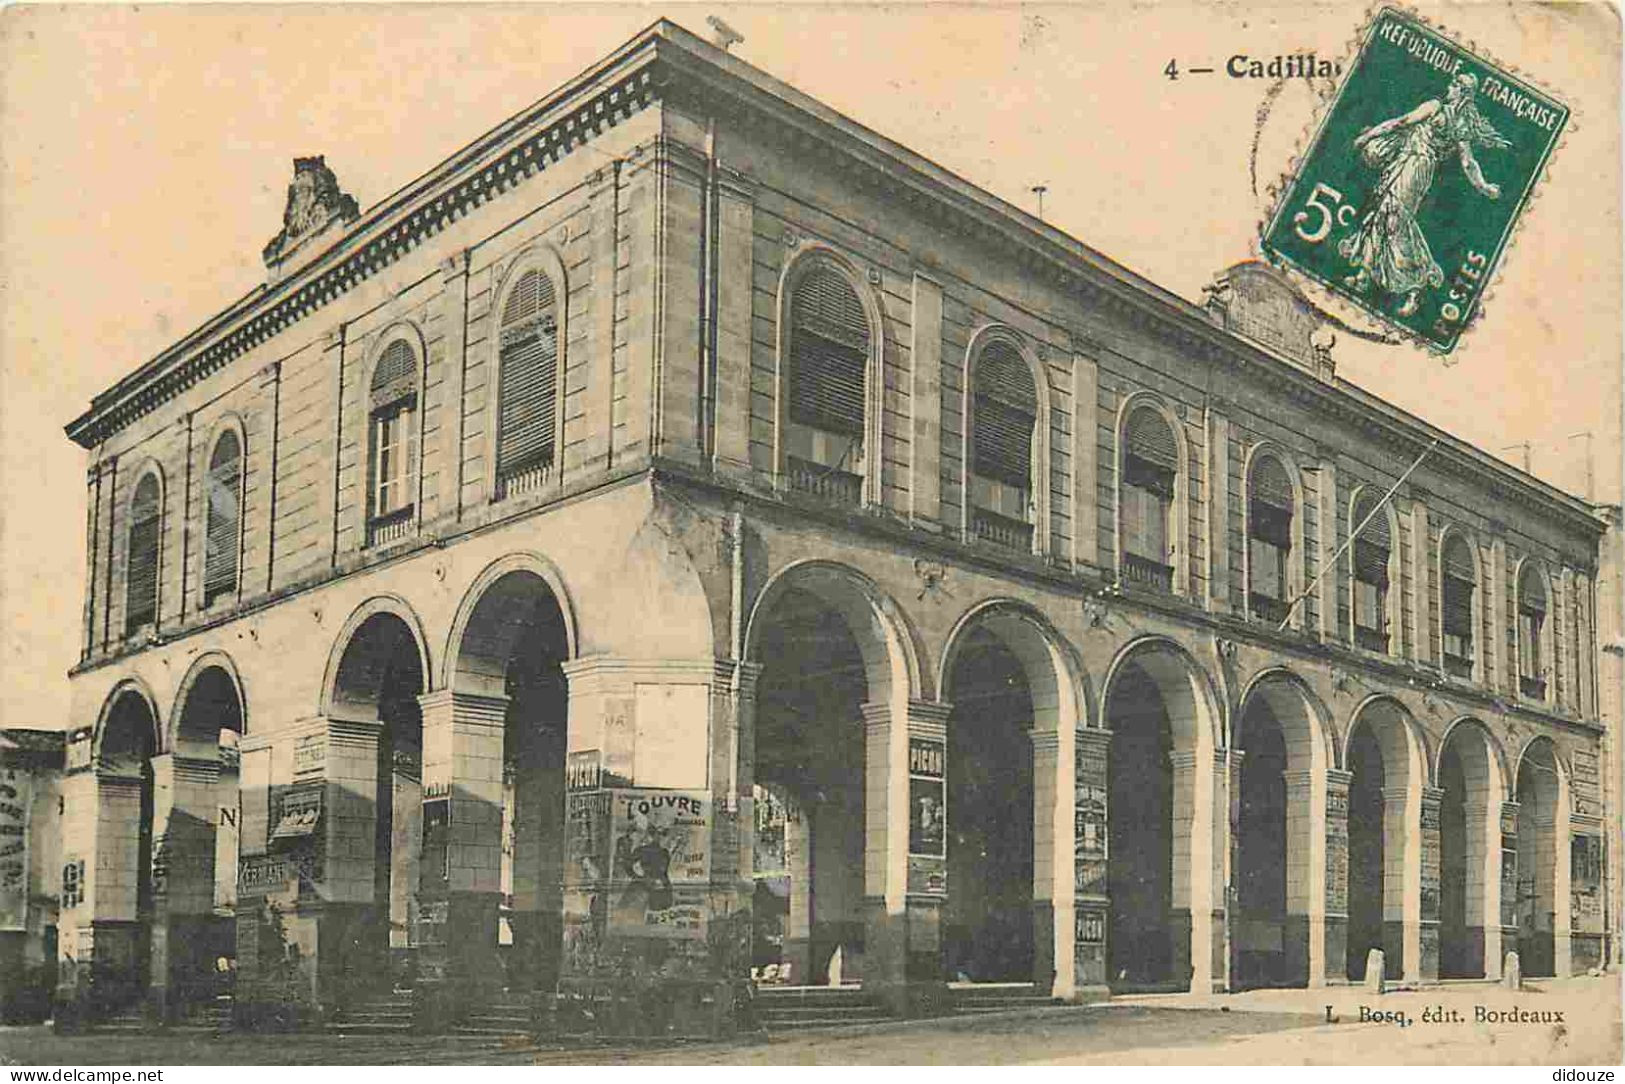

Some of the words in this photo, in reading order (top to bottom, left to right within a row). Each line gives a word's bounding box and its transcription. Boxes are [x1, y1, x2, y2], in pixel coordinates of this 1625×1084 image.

[1481, 76, 1557, 131] FRANÇAISE
[220, 807, 236, 827] N
[627, 796, 701, 819] LOUVRE
